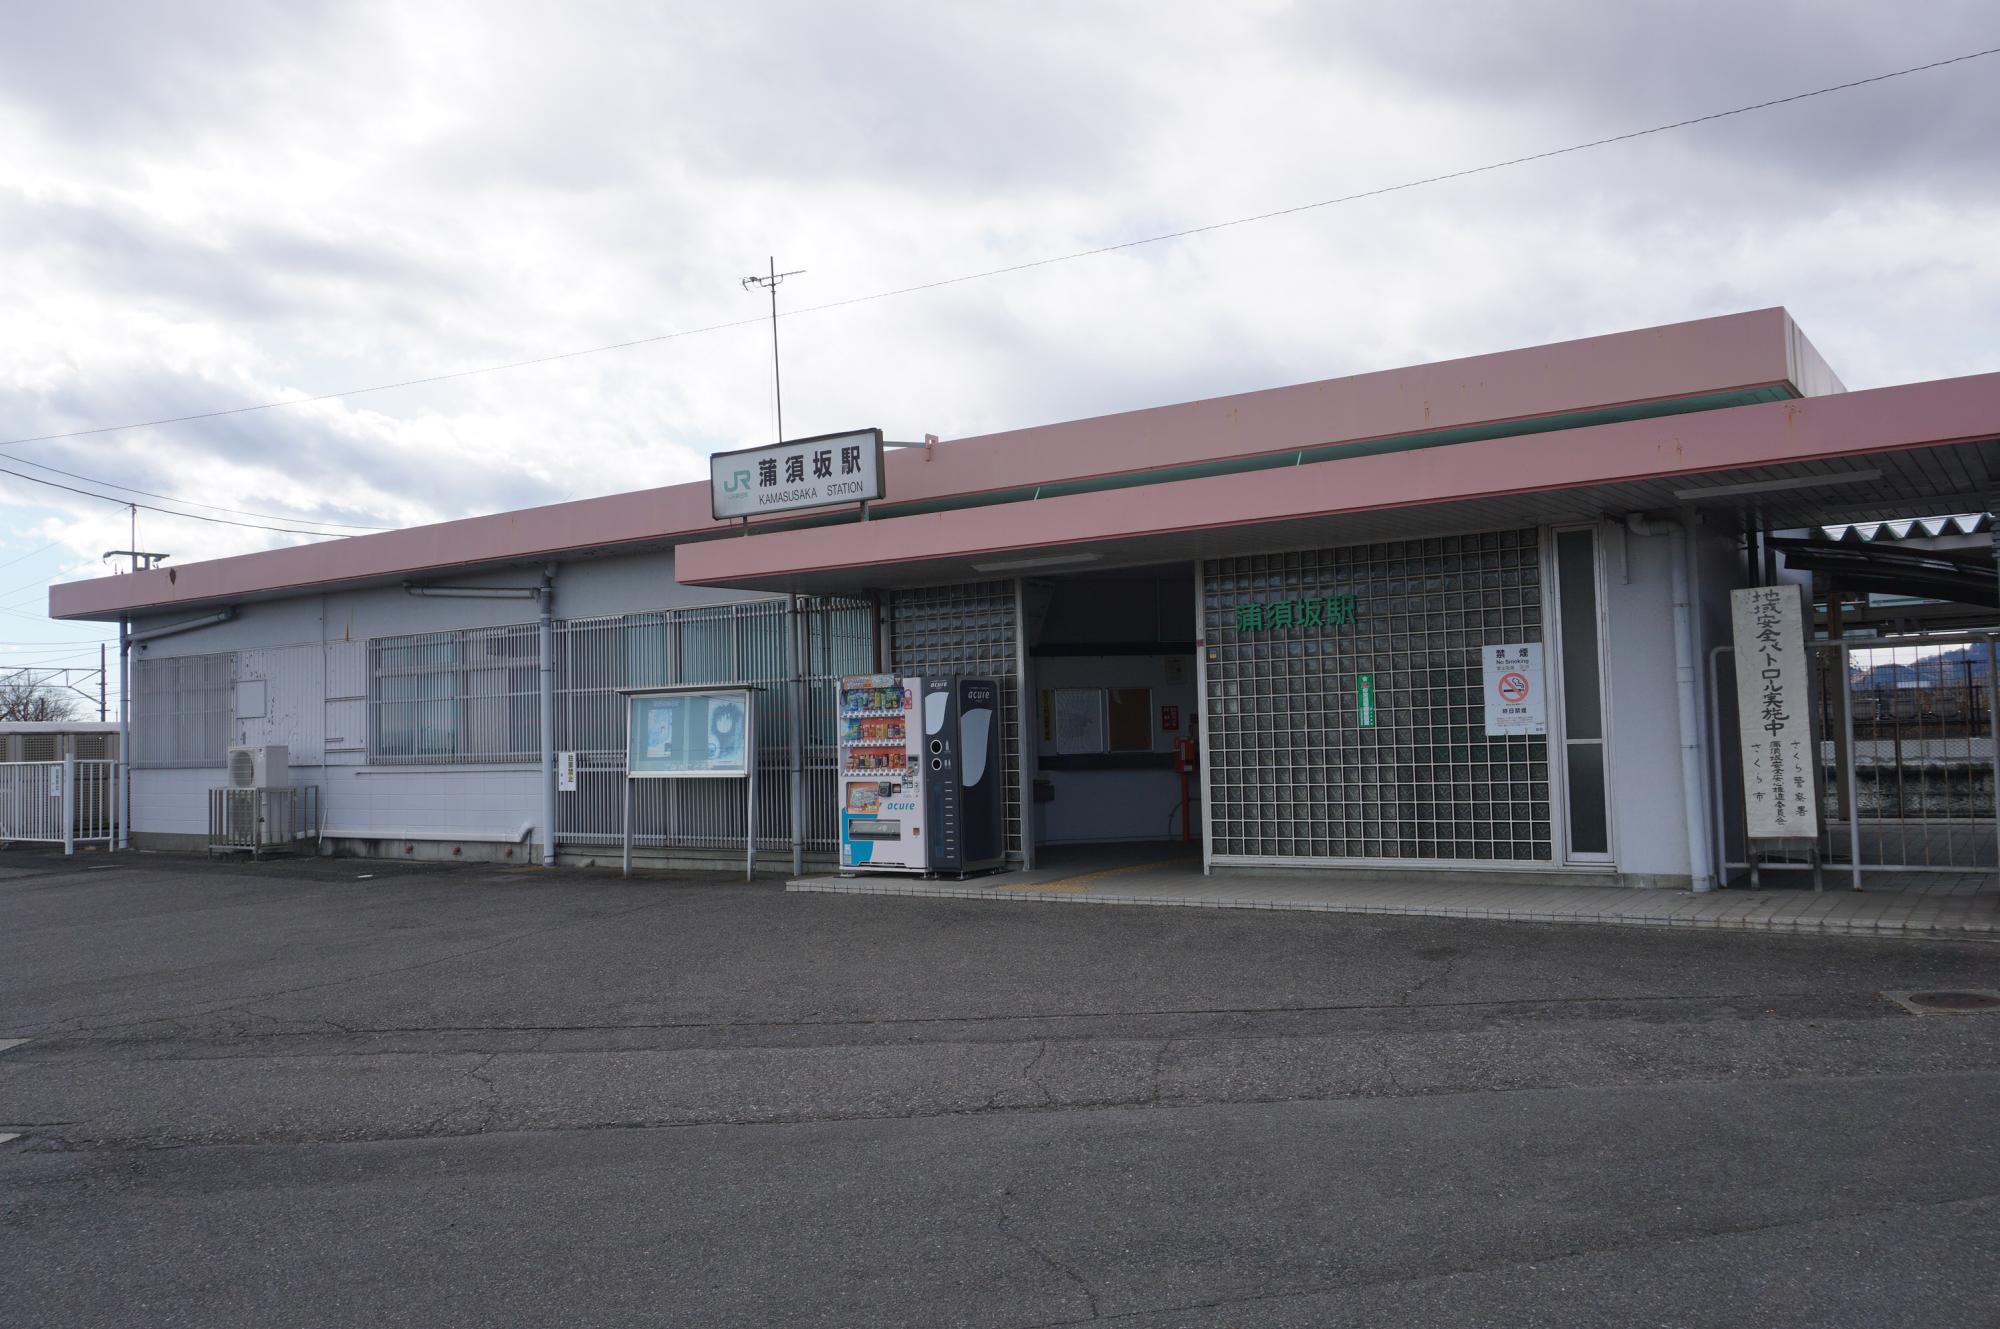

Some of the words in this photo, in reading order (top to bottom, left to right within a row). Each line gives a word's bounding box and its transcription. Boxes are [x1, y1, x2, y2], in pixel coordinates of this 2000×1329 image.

[724, 470, 751, 492] JR
[758, 445, 862, 488] 蒲須坂駅
[758, 487, 818, 505] KAMASUSAKA
[827, 480, 863, 497] STATION
[1236, 594, 1358, 632] 蒲須坂駅
[1752, 589, 1789, 737] 地域安全パトロール実施中
[968, 691, 990, 699] acure
[1751, 743, 1766, 802] さくら市
[888, 802, 915, 810] acure
